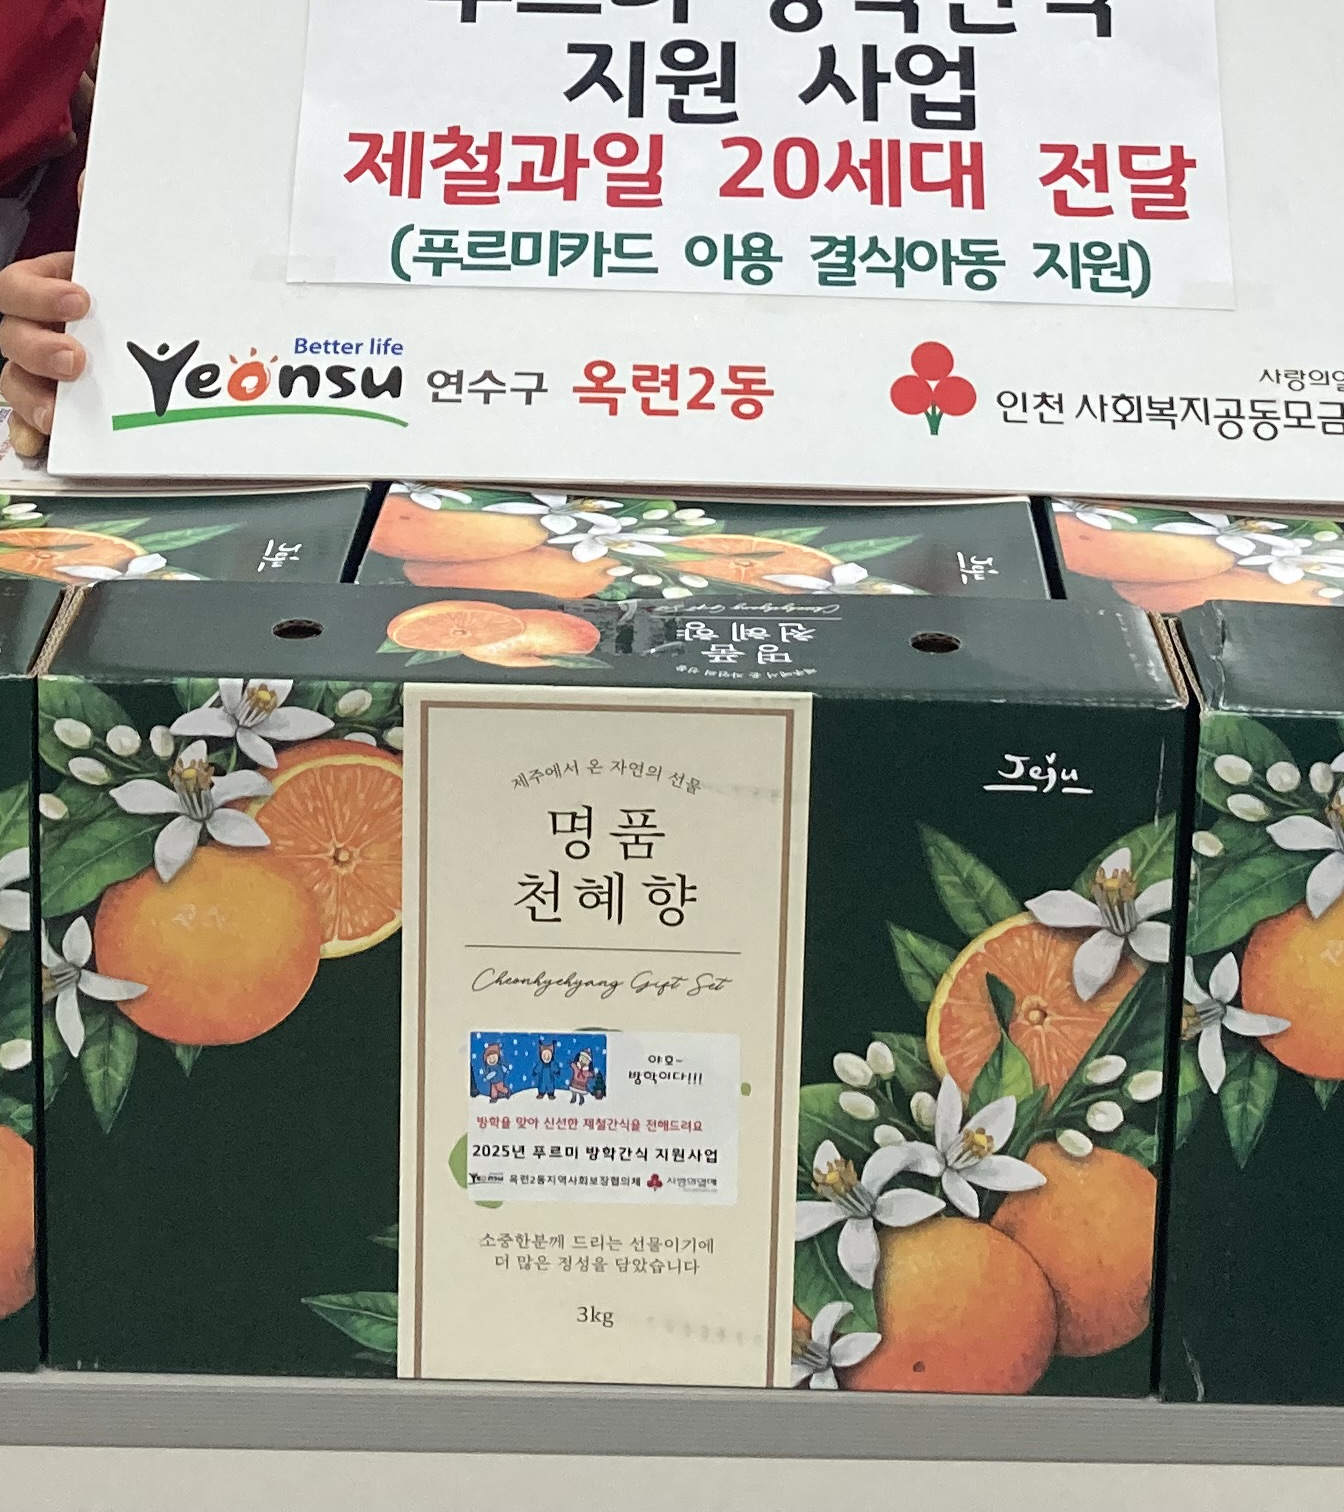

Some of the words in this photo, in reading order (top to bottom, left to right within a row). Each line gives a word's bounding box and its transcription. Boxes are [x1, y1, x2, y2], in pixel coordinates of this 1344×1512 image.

[563, 39, 739, 124] 지원
[798, 44, 976, 130] 사업
[343, 125, 664, 208] 제철과일
[719, 136, 985, 210] 20세대
[1039, 143, 1197, 220] 전달
[391, 223, 659, 282] (푸르미카드
[684, 231, 783, 286] 이용
[810, 234, 1006, 290] 결식아동
[1032, 238, 1151, 299] 지원)
[293, 336, 363, 357] Better
[369, 337, 404, 357] life
[126, 339, 403, 418] Yeonsu
[426, 368, 549, 407] 연수구
[571, 359, 775, 420] 옥련2동
[996, 390, 1064, 426] 인천
[510, 759, 580, 791] 제주에서
[586, 758, 604, 775] 온
[609, 759, 663, 782] 자연의
[997, 752, 1078, 793] Jeju
[547, 804, 666, 861] 명품
[514, 869, 698, 927] 천혜향
[472, 1143, 526, 1161] 2025년
[532, 1144, 579, 1161] 푸르미
[585, 1145, 648, 1163] 방학간식
[655, 1147, 719, 1164] 지원사업
[479, 1231, 565, 1251] 소중한분께
[572, 1234, 623, 1252] 드리는
[629, 1235, 715, 1255] 선물이기에
[494, 1253, 510, 1271] 더
[517, 1254, 551, 1272] 많은
[558, 1255, 608, 1273] 정성을
[615, 1257, 700, 1276] 담았습니다
[576, 1306, 614, 1328] 3kg
